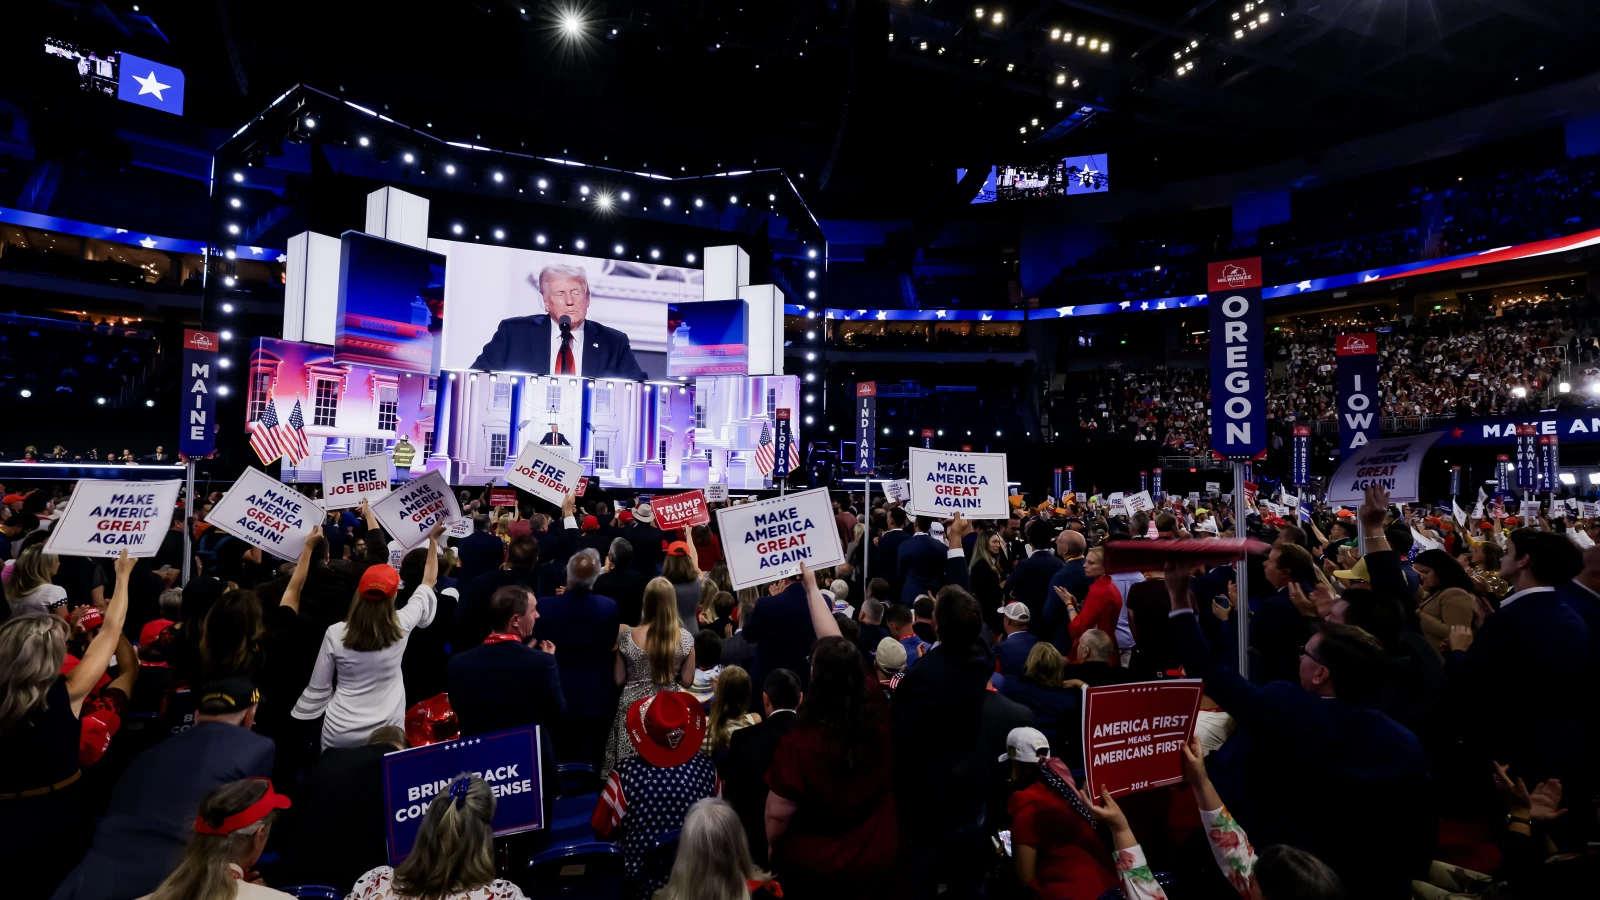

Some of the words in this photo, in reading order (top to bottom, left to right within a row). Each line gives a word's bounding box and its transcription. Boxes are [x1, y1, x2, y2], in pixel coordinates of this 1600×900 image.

[1222, 296, 1252, 444] OREGON
[190, 363, 209, 440] MAINE
[1344, 374, 1374, 448] IOWA
[860, 398, 870, 469] INDIANA
[777, 420, 786, 473] FLORIDA
[531, 459, 565, 482] FIRE
[937, 462, 975, 473] MAKE
[1356, 453, 1409, 466] AMERICA
[1526, 437, 1535, 484] HAWAII
[342, 468, 377, 484] FIRE
[515, 465, 538, 479] JOE
[537, 474, 570, 494] BIDEN
[926, 472, 988, 485] AMERICA
[1356, 465, 1397, 478] GREAT
[329, 484, 354, 495] JOE
[358, 480, 387, 493] BIDEN
[400, 484, 432, 506] MAKE
[935, 485, 979, 496] GREAT
[110, 494, 155, 505] MAKE
[264, 489, 302, 515] MAKE
[399, 490, 444, 520] AMERICA
[657, 498, 700, 516] TRUMP
[934, 496, 981, 508] AGAIN!
[89, 507, 158, 518] AMERICA
[245, 495, 303, 529] AMERICA
[247, 508, 290, 534] GREAT
[412, 500, 445, 523] GREAT
[418, 508, 450, 532] AGAIN!
[664, 508, 699, 522] VANCE
[754, 507, 798, 527] MAKE
[97, 520, 149, 531] GREAT
[236, 517, 284, 544] AGAIN!
[744, 518, 815, 544] AMERICA
[87, 533, 146, 545] AGAIN!
[245, 534, 261, 544] 2024
[757, 533, 806, 554] GREAT
[760, 546, 812, 570] AGAIN!
[1093, 719, 1149, 738] AMERICA
[1152, 715, 1189, 729] FIRST
[1128, 734, 1151, 745] MEANS
[1093, 744, 1154, 767] AMERICANS
[1156, 740, 1183, 755] FIRST
[408, 778, 452, 801] BRIN
[495, 779, 531, 797] ENSE
[1131, 781, 1149, 790] 2024
